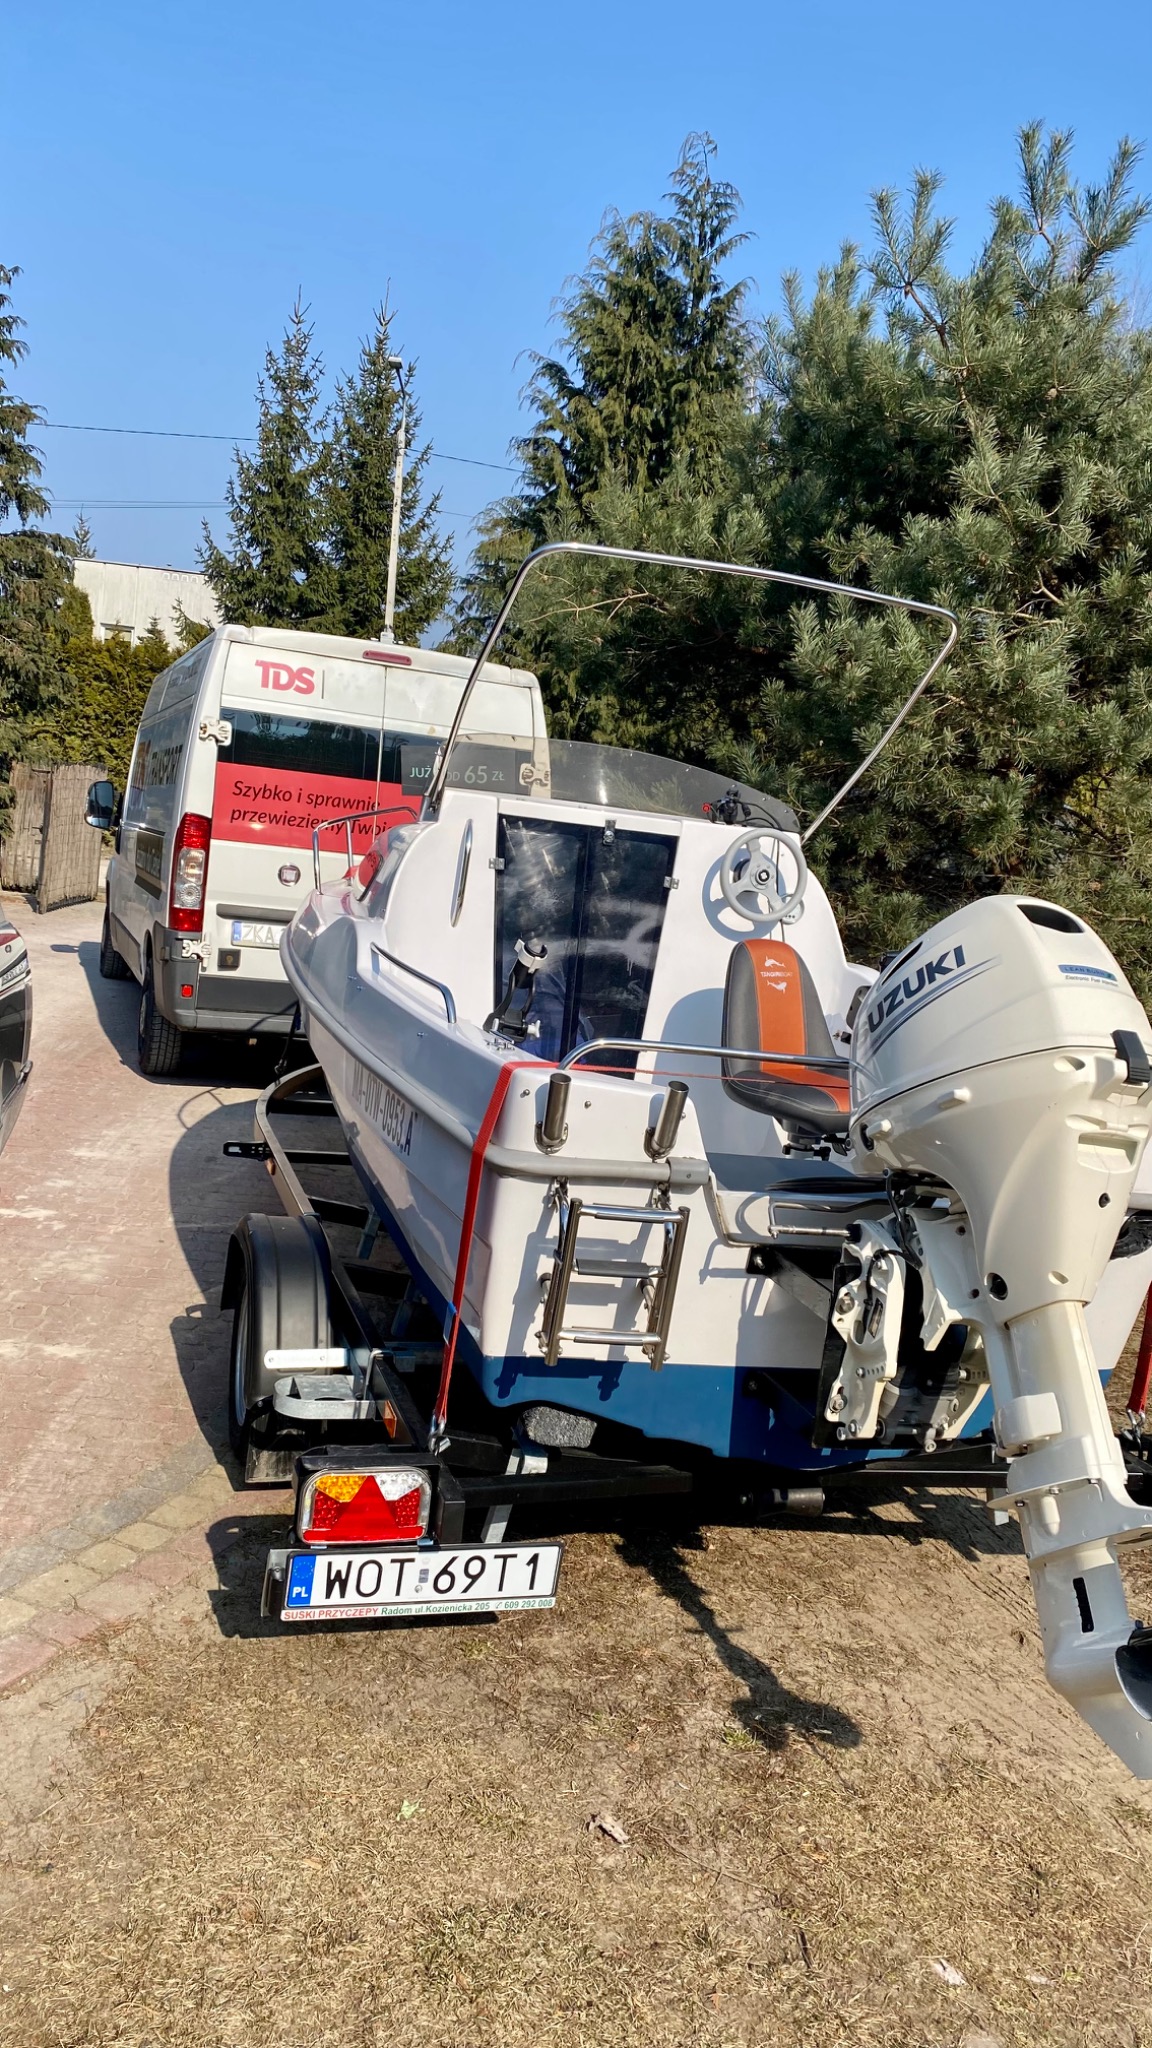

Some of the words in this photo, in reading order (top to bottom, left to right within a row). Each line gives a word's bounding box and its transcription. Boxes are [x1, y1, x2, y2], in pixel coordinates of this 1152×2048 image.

[255, 659, 316, 696] TDS
[464, 765, 488, 784] 65
[491, 770, 505, 781] ZŁ
[232, 780, 293, 802] Szybko
[297, 787, 303, 803] i
[306, 792, 380, 812] sprawnie
[242, 924, 275, 943] ZKA
[325, 1557, 416, 1600] WOT
[432, 1552, 540, 1595] 69T1
[292, 1586, 309, 1598] PL
[284, 1610, 316, 1620] SUSKI
[318, 1607, 379, 1618] PRZYCZEPY
[381, 1606, 413, 1615] Radom
[475, 1602, 490, 1611] 205
[504, 1600, 519, 1609] 609
[521, 1599, 536, 1608] 292
